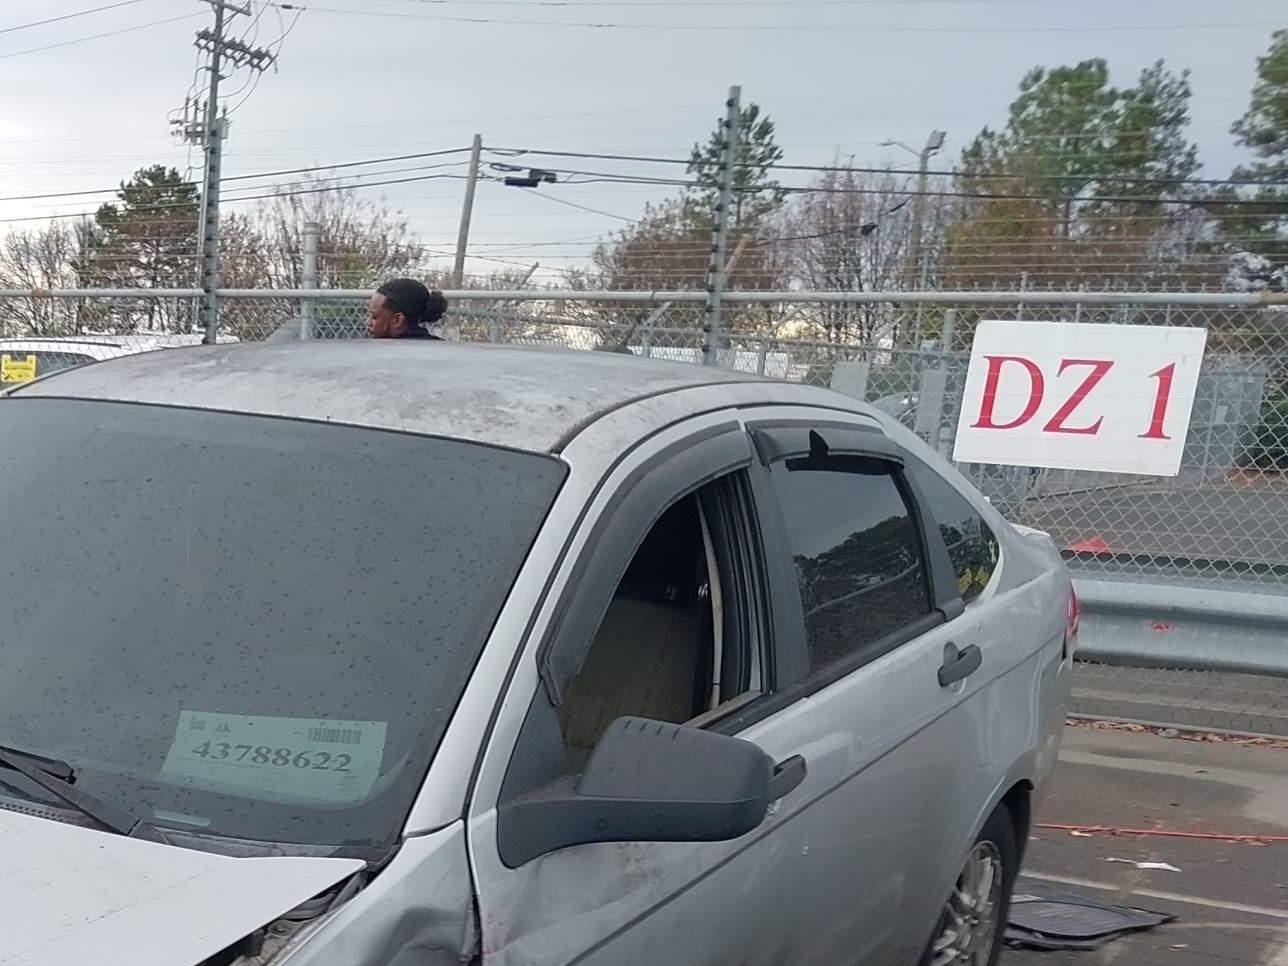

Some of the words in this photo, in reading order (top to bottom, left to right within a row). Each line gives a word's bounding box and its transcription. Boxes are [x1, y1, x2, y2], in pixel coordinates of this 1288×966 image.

[969, 354, 1115, 435] DZ
[1137, 362, 1176, 440] 1
[191, 740, 353, 773] 43788622
